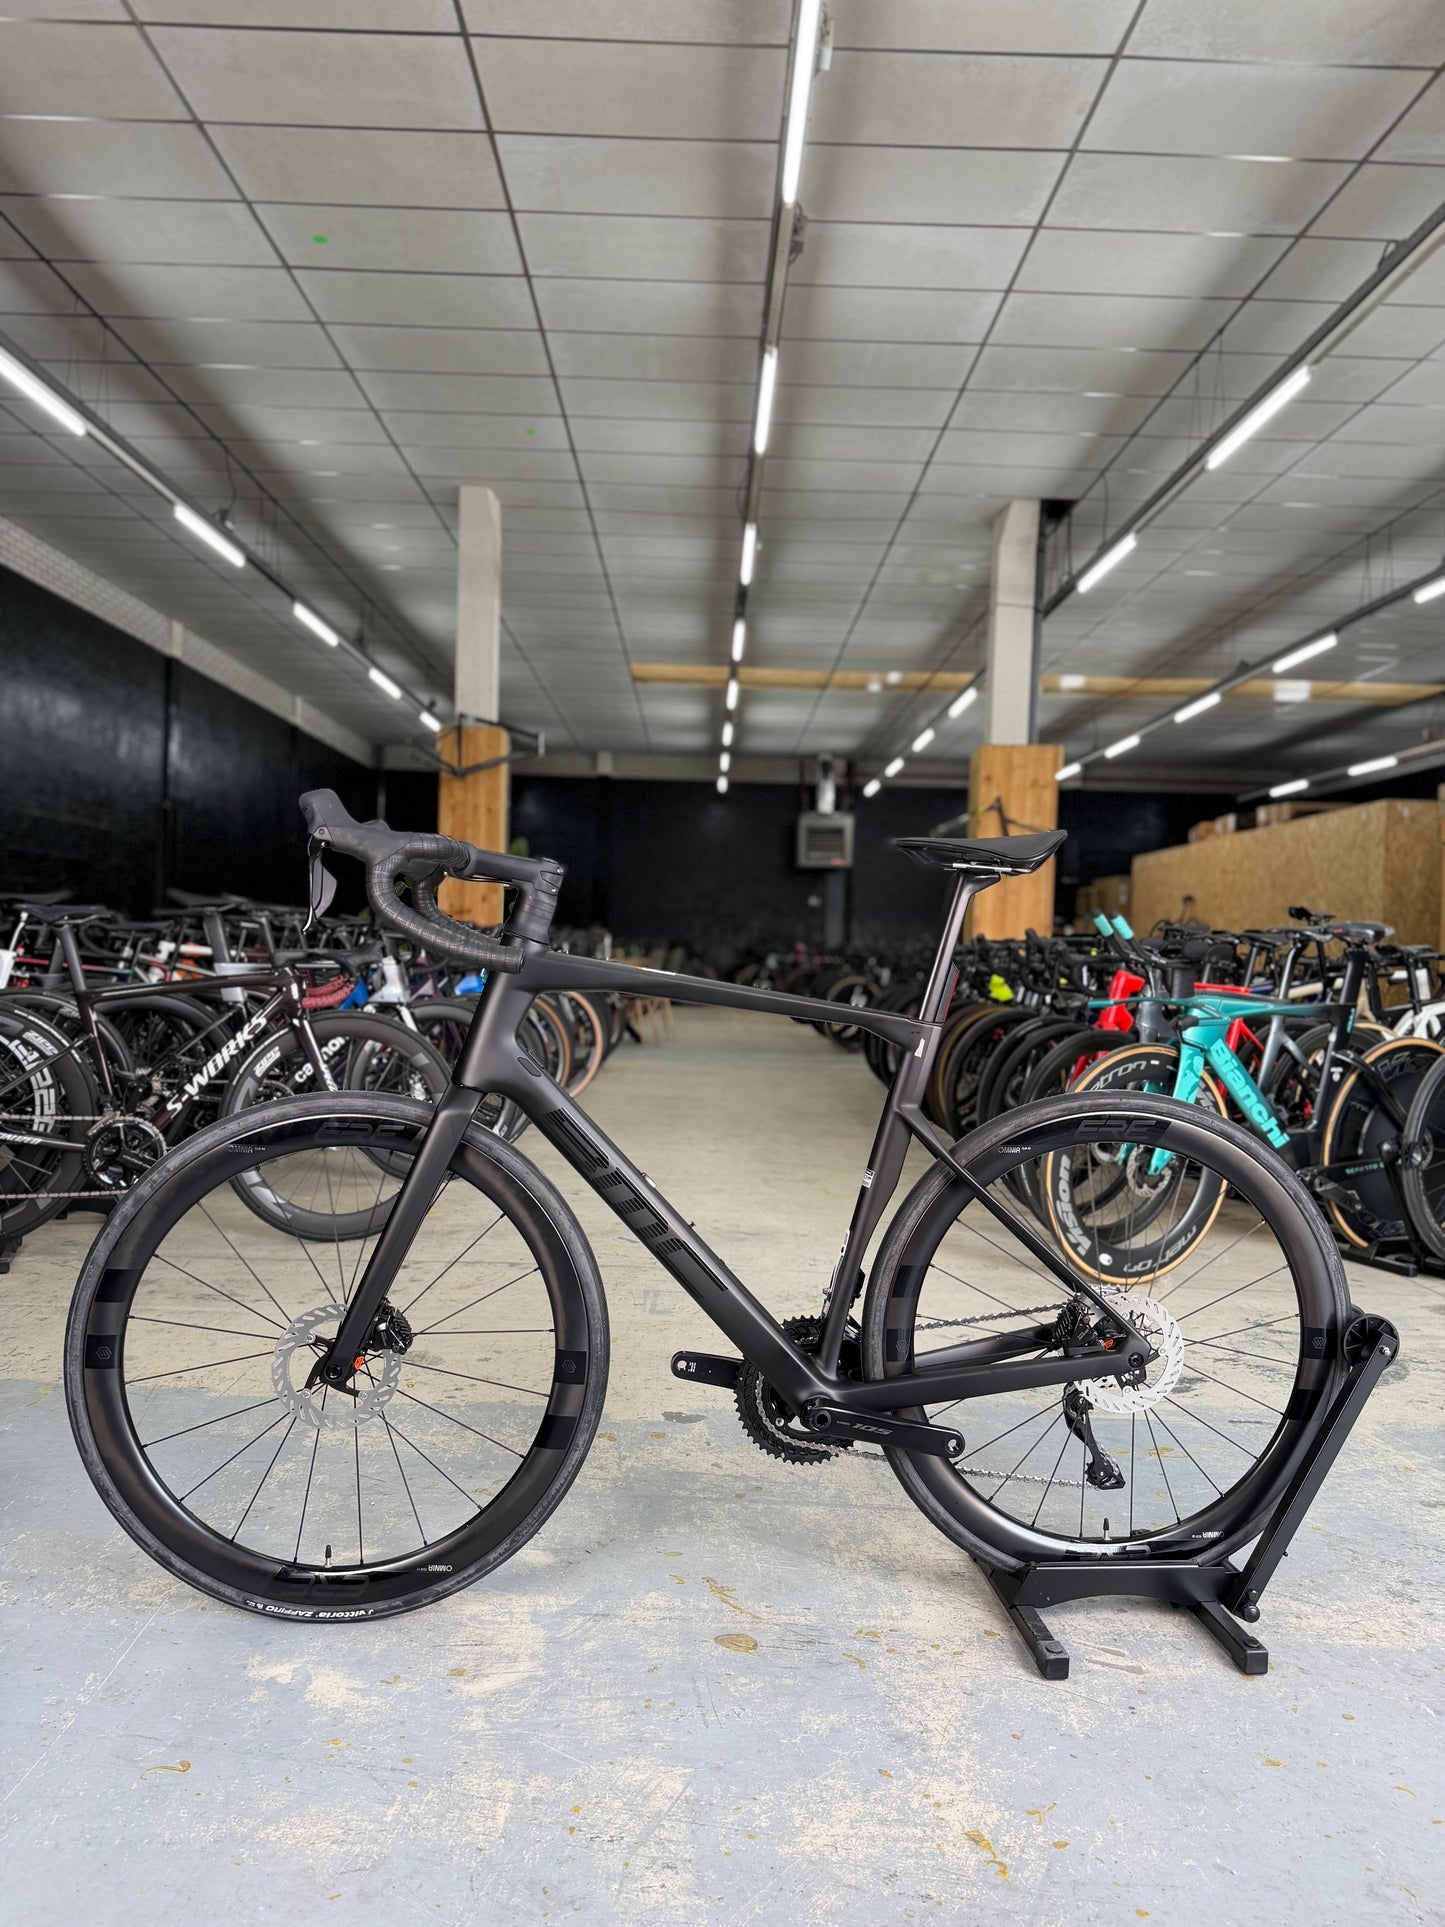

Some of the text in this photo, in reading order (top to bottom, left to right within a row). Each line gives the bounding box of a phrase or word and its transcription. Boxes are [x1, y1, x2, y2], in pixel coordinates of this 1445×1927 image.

[166, 1009, 267, 1119] S-WORKS
[1210, 1038, 1290, 1148] Bianchi
[1074, 1119, 1157, 1139] ERE
[997, 1146, 1021, 1154] OMNIA
[851, 1422, 894, 1435] 105
[428, 1564, 453, 1572] OMNIA
[266, 1605, 314, 1617] ZAFFIRO
